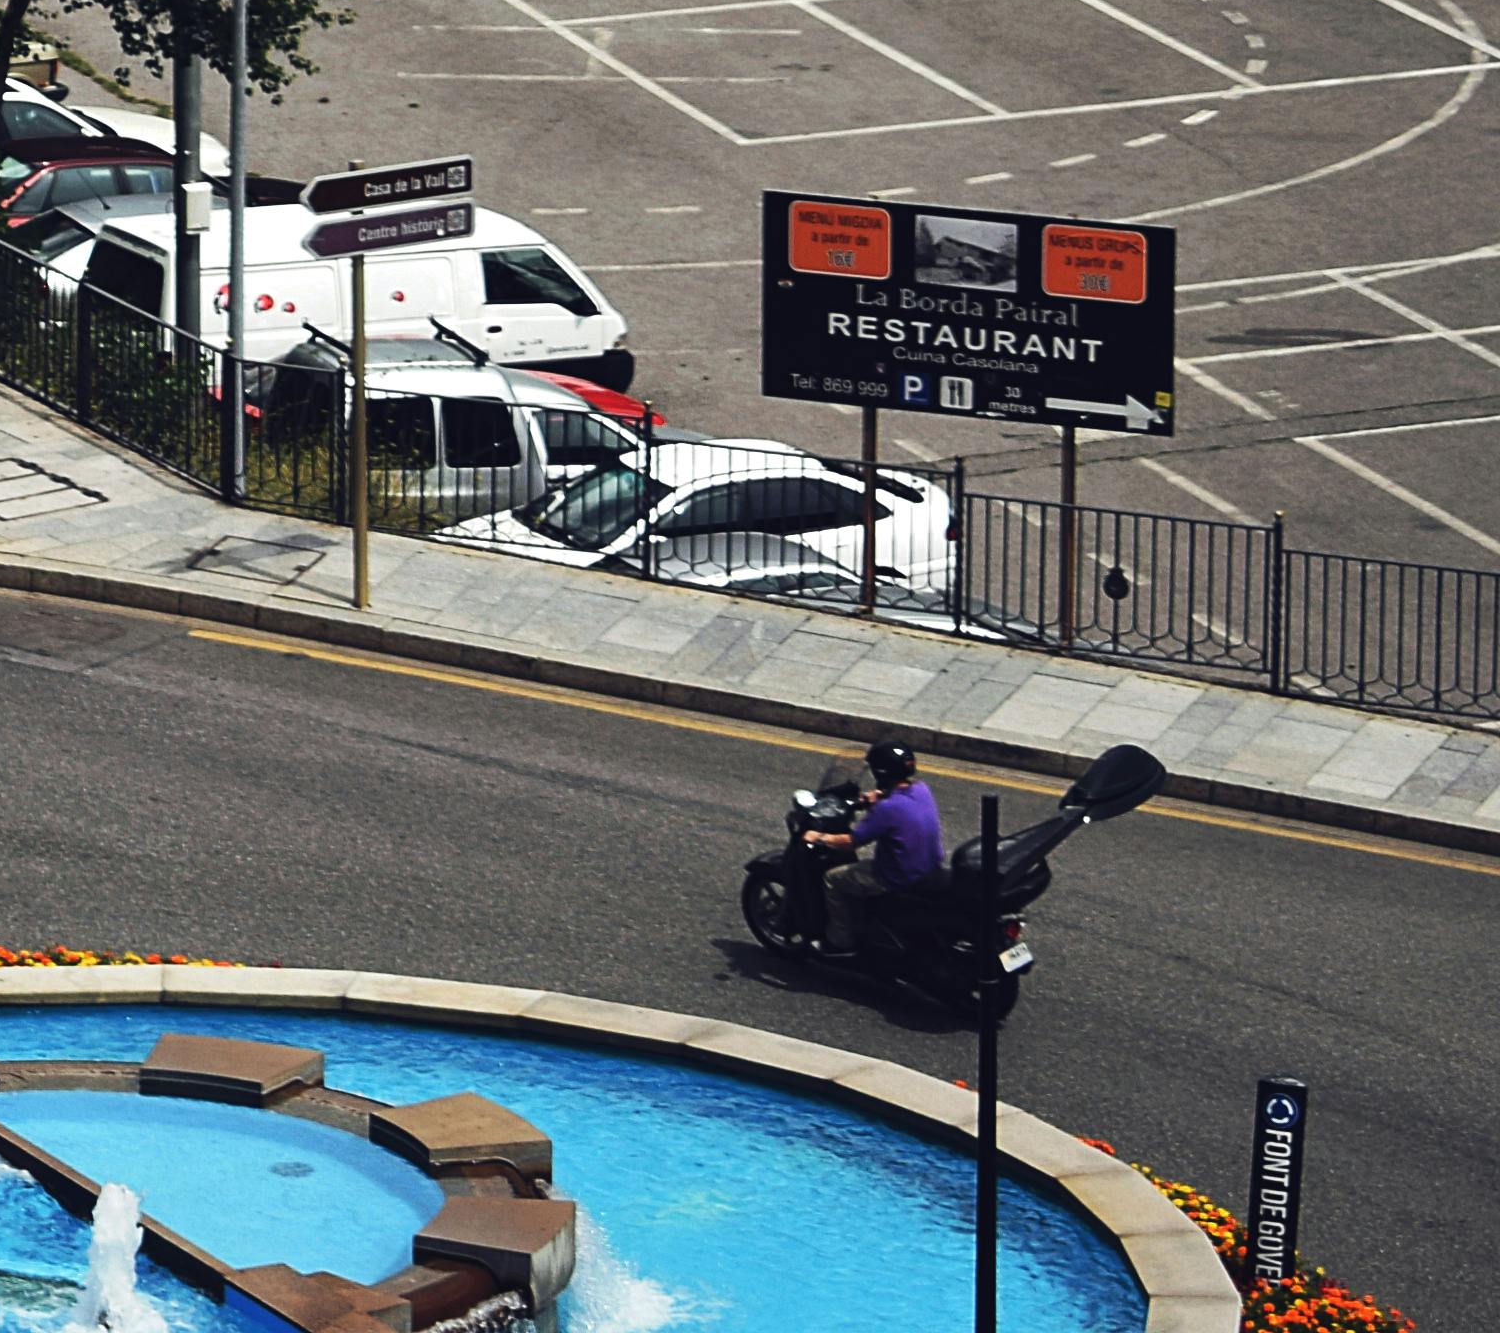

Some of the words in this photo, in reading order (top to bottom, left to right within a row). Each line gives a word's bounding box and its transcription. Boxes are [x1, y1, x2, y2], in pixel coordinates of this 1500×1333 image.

[364, 182, 391, 197] Casa
[395, 179, 408, 192] de
[411, 176, 421, 190] la
[424, 172, 445, 188] Vall
[358, 224, 397, 242] Centre
[821, 233, 851, 245] partir
[855, 235, 869, 247] de
[1075, 256, 1106, 269] partir
[1108, 258, 1125, 271] de
[856, 284, 888, 307] La
[900, 288, 984, 318] Borda
[995, 297, 1079, 328] Pairal
[827, 311, 1104, 363] RESTAURANT
[893, 345, 946, 365] Cuina
[952, 351, 1039, 374] Casolana
[791, 373, 817, 390] Tel:
[858, 380, 889, 398] 999
[988, 401, 1037, 414] metres
[1261, 1128, 1293, 1188] FONT
[1259, 1188, 1289, 1220] DE
[1255, 1220, 1286, 1288] GOVE
